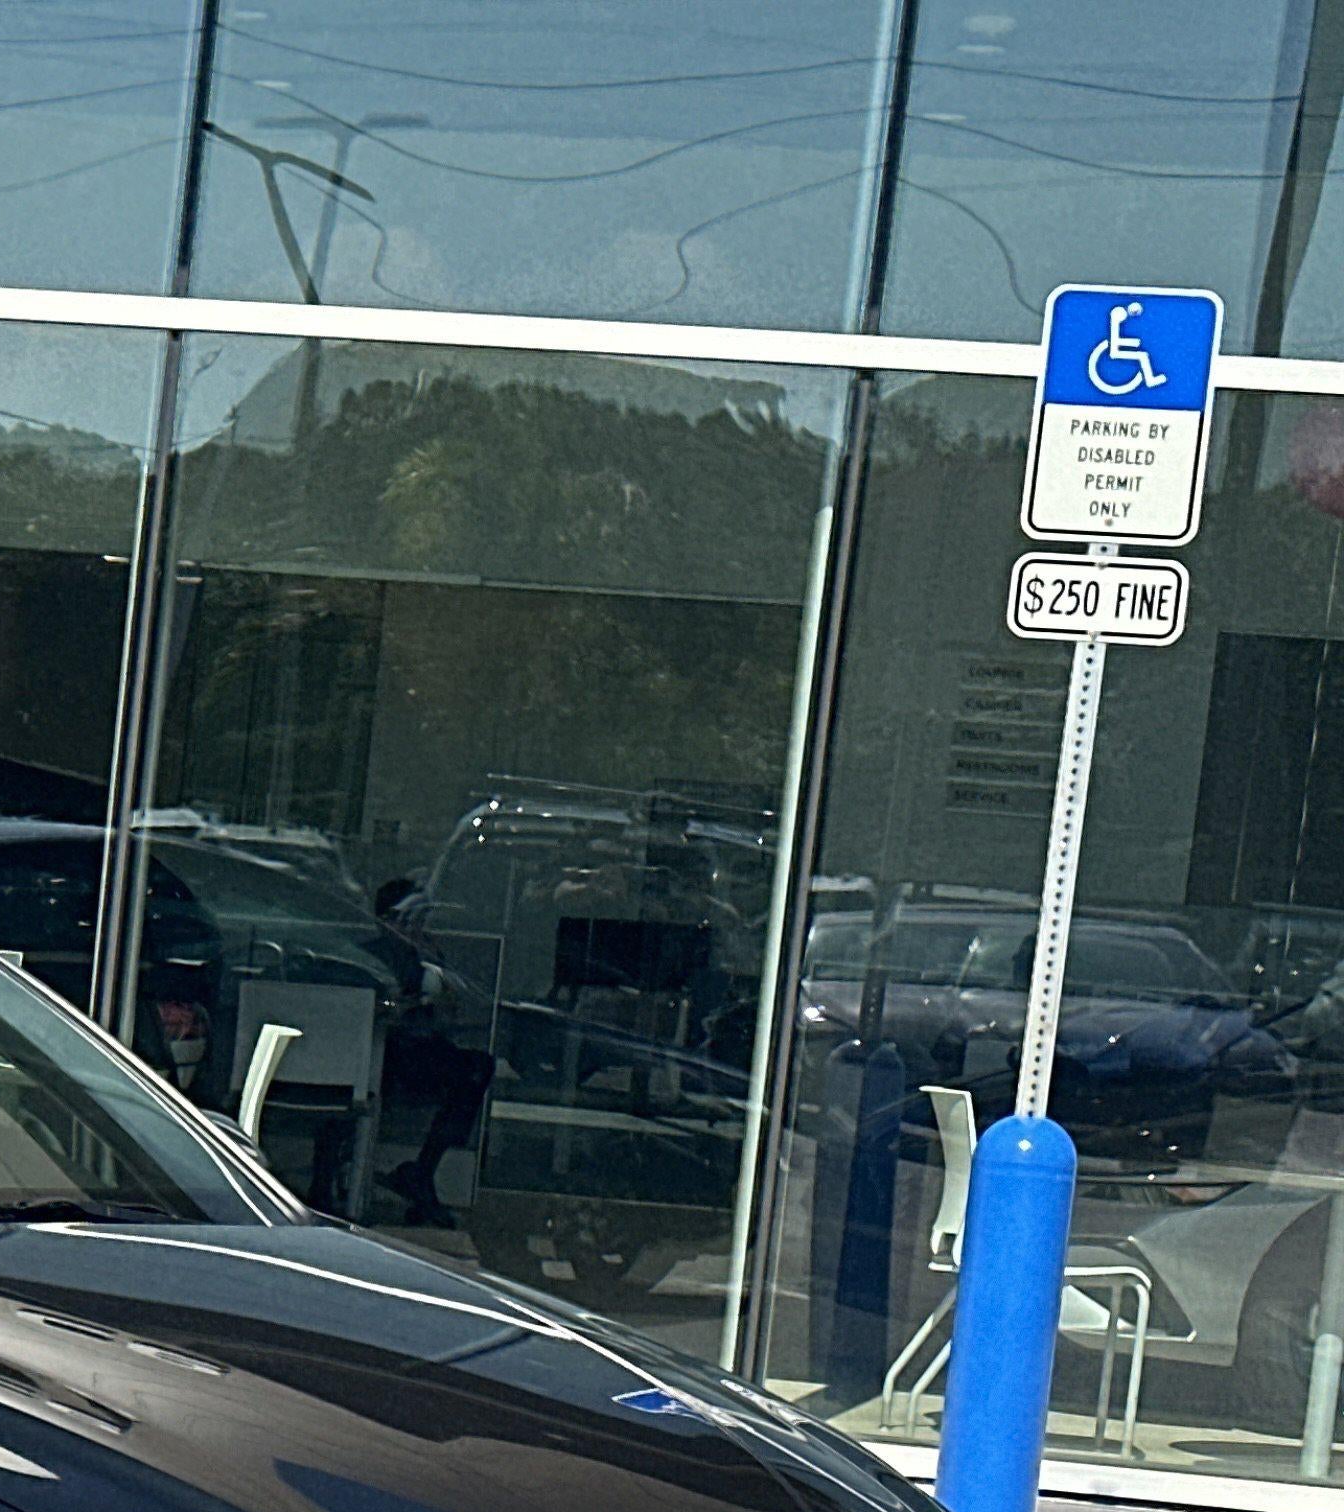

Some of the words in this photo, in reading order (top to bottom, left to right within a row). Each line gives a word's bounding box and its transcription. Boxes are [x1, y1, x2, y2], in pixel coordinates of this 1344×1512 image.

[1070, 419, 1140, 438] PARKING
[1149, 423, 1170, 440] BY
[1077, 446, 1155, 465] DISABLED
[1084, 473, 1144, 492] PERMIT
[1089, 500, 1132, 518] ONLY
[1023, 574, 1099, 618] $250
[1114, 583, 1173, 621] FINE
